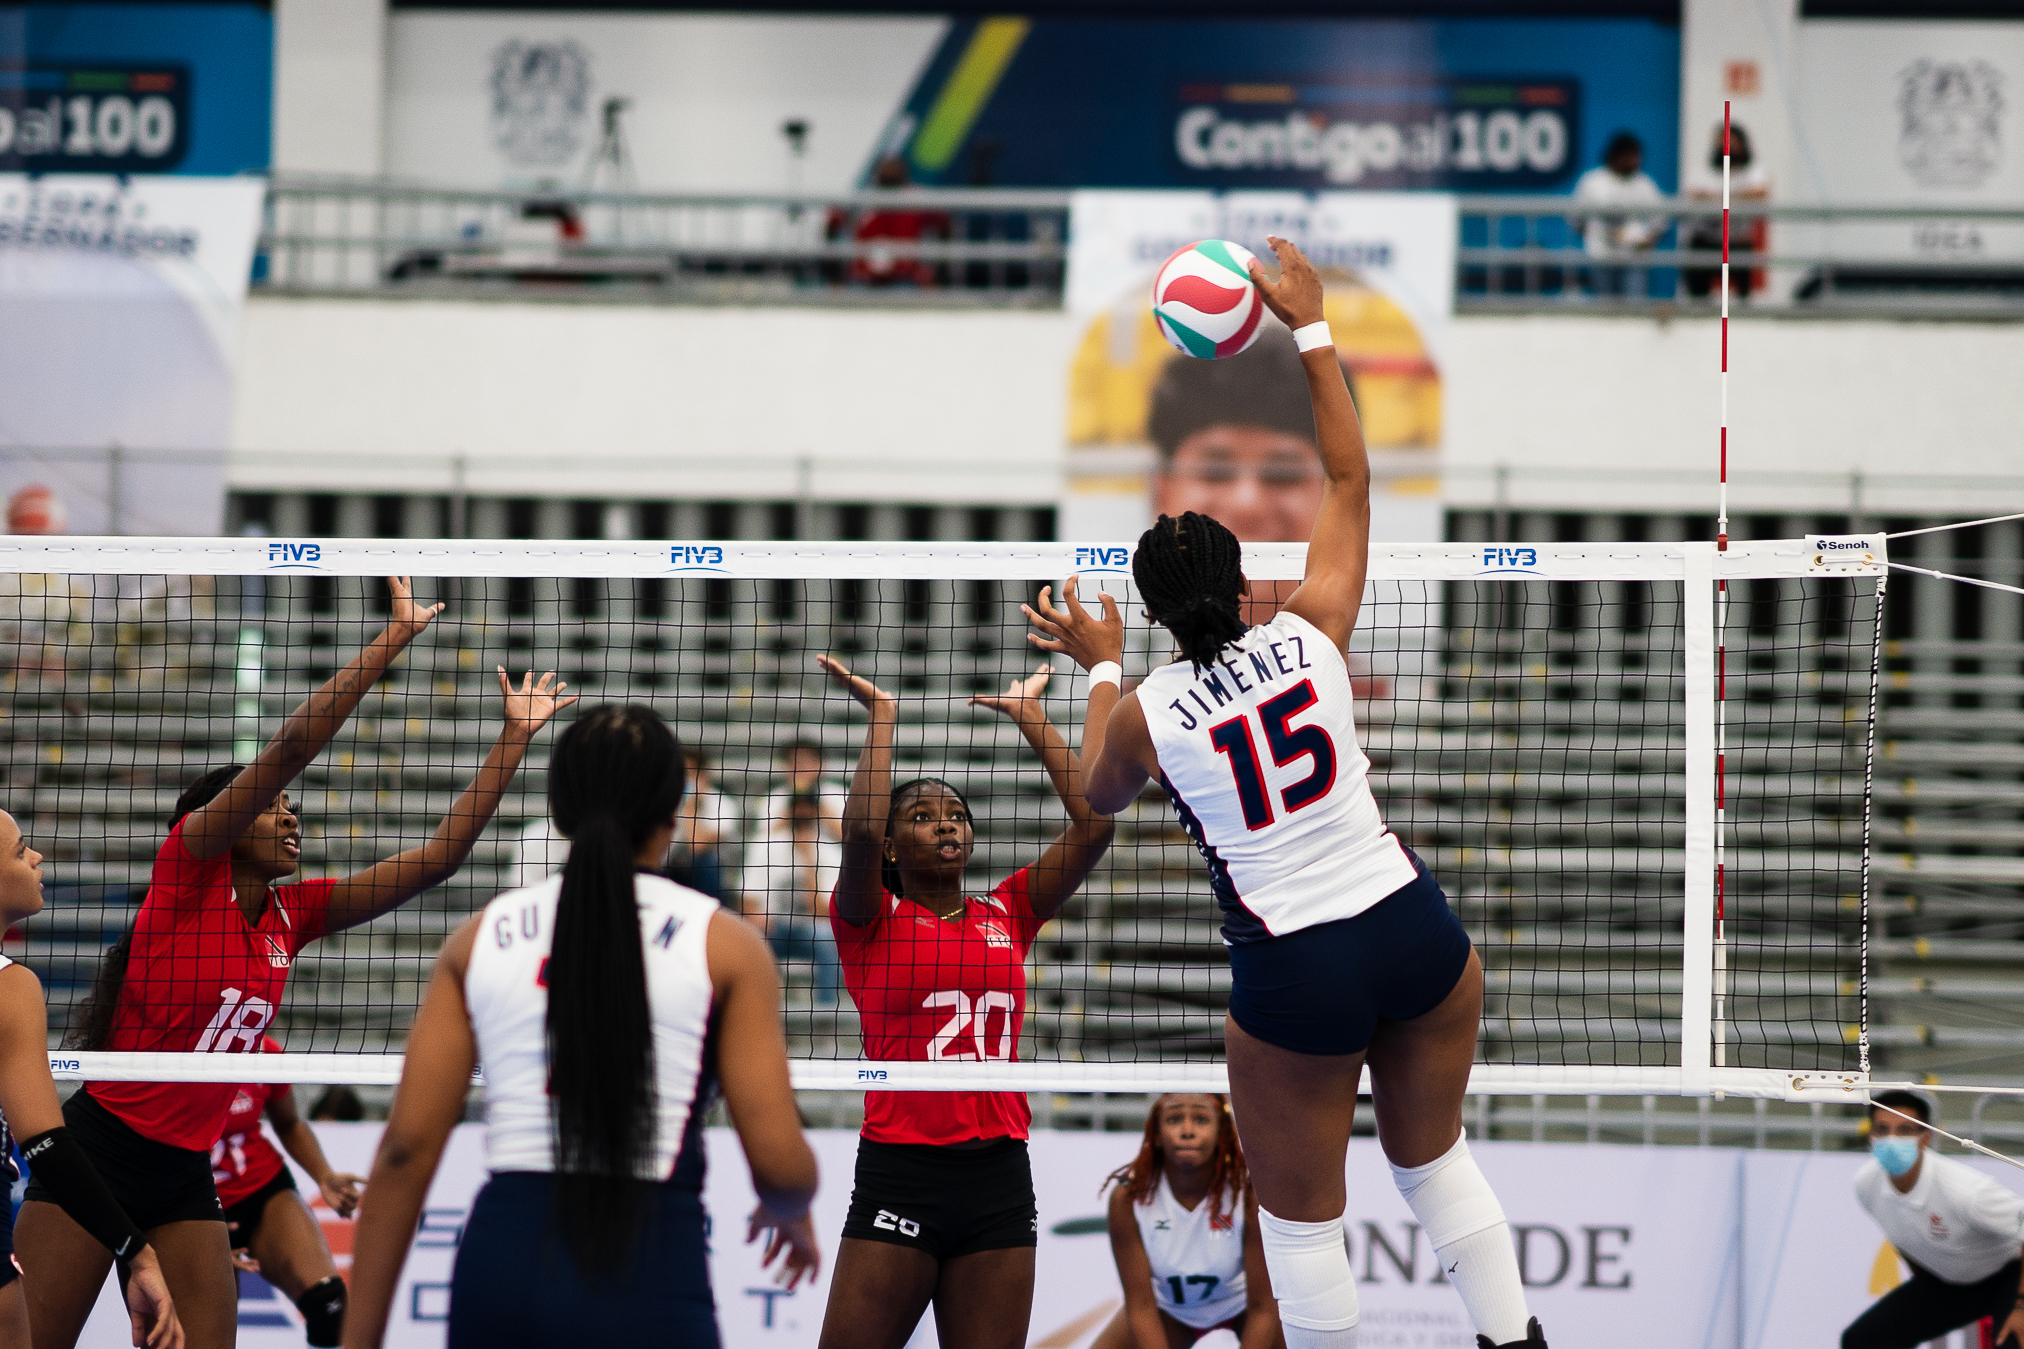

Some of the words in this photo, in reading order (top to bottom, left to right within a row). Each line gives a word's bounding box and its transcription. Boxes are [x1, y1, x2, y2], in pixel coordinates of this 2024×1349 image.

[64, 95, 177, 158] 100
[1450, 110, 1569, 173] 100
[269, 543, 321, 561] FIVB
[671, 546, 723, 564] FIVB
[1076, 548, 1128, 566] FIVB
[1484, 548, 1537, 566] FIVB
[1828, 540, 1869, 550] Senoh
[1168, 636, 1312, 731] JIMENEZ
[1208, 677, 1338, 832] 15
[194, 986, 274, 1054] 18
[922, 989, 1016, 1063] 20
[50, 1059, 80, 1070] FIVB
[858, 1070, 887, 1080] FIVB
[873, 1209, 920, 1238] 20
[1167, 1275, 1221, 1304] 17
